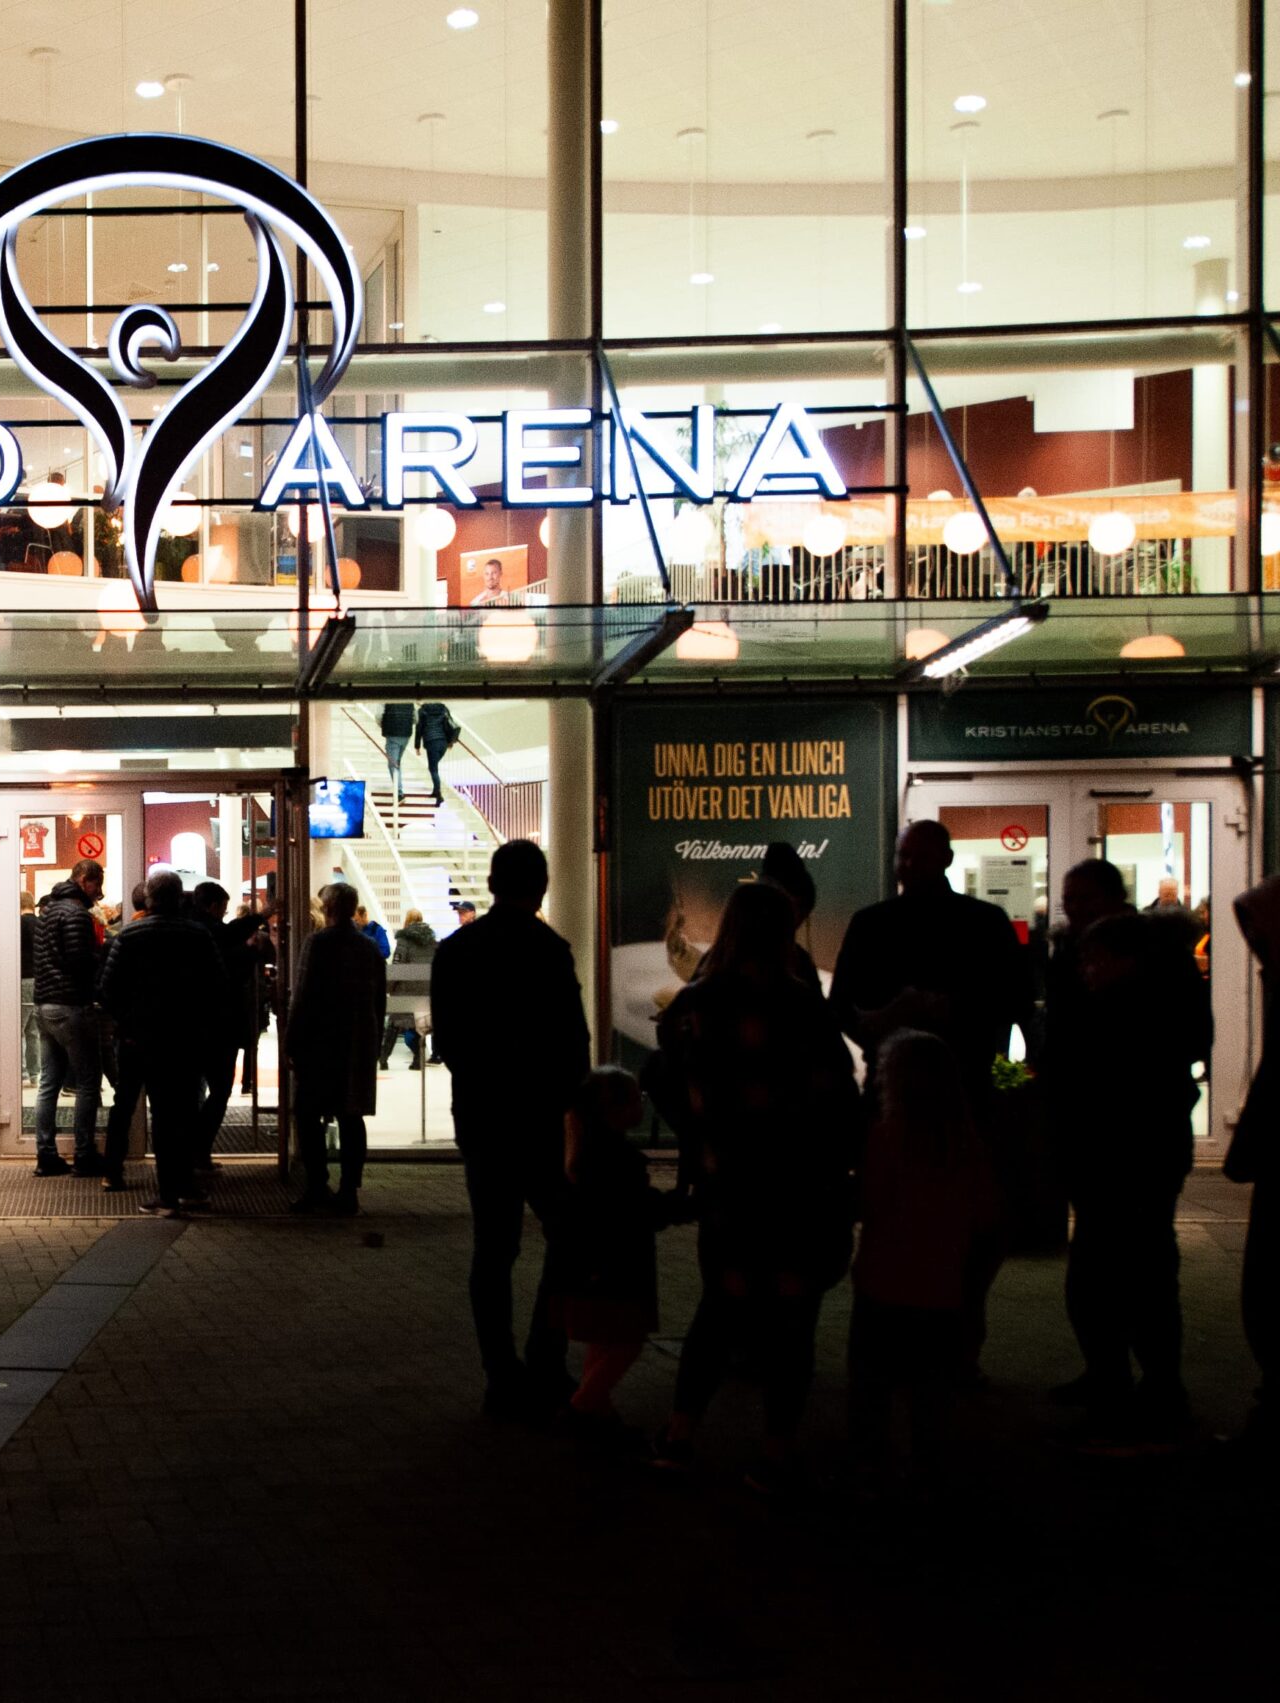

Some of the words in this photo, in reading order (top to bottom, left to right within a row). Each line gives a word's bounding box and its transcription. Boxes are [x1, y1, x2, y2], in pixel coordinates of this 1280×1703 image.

[254, 402, 849, 510] ARENA
[965, 724, 1098, 738] KRISTIANSTAD
[1124, 722, 1190, 735] ARENA
[654, 743, 708, 777] UNNA
[714, 743, 745, 777] DIG
[751, 742, 777, 776] EN
[781, 740, 846, 775] LUNCH
[648, 779, 722, 821] UTÖVER
[728, 785, 763, 820] DET
[768, 784, 852, 819] VANLIGA
[675, 839, 767, 860] Välkomm
[796, 838, 830, 860] in!
